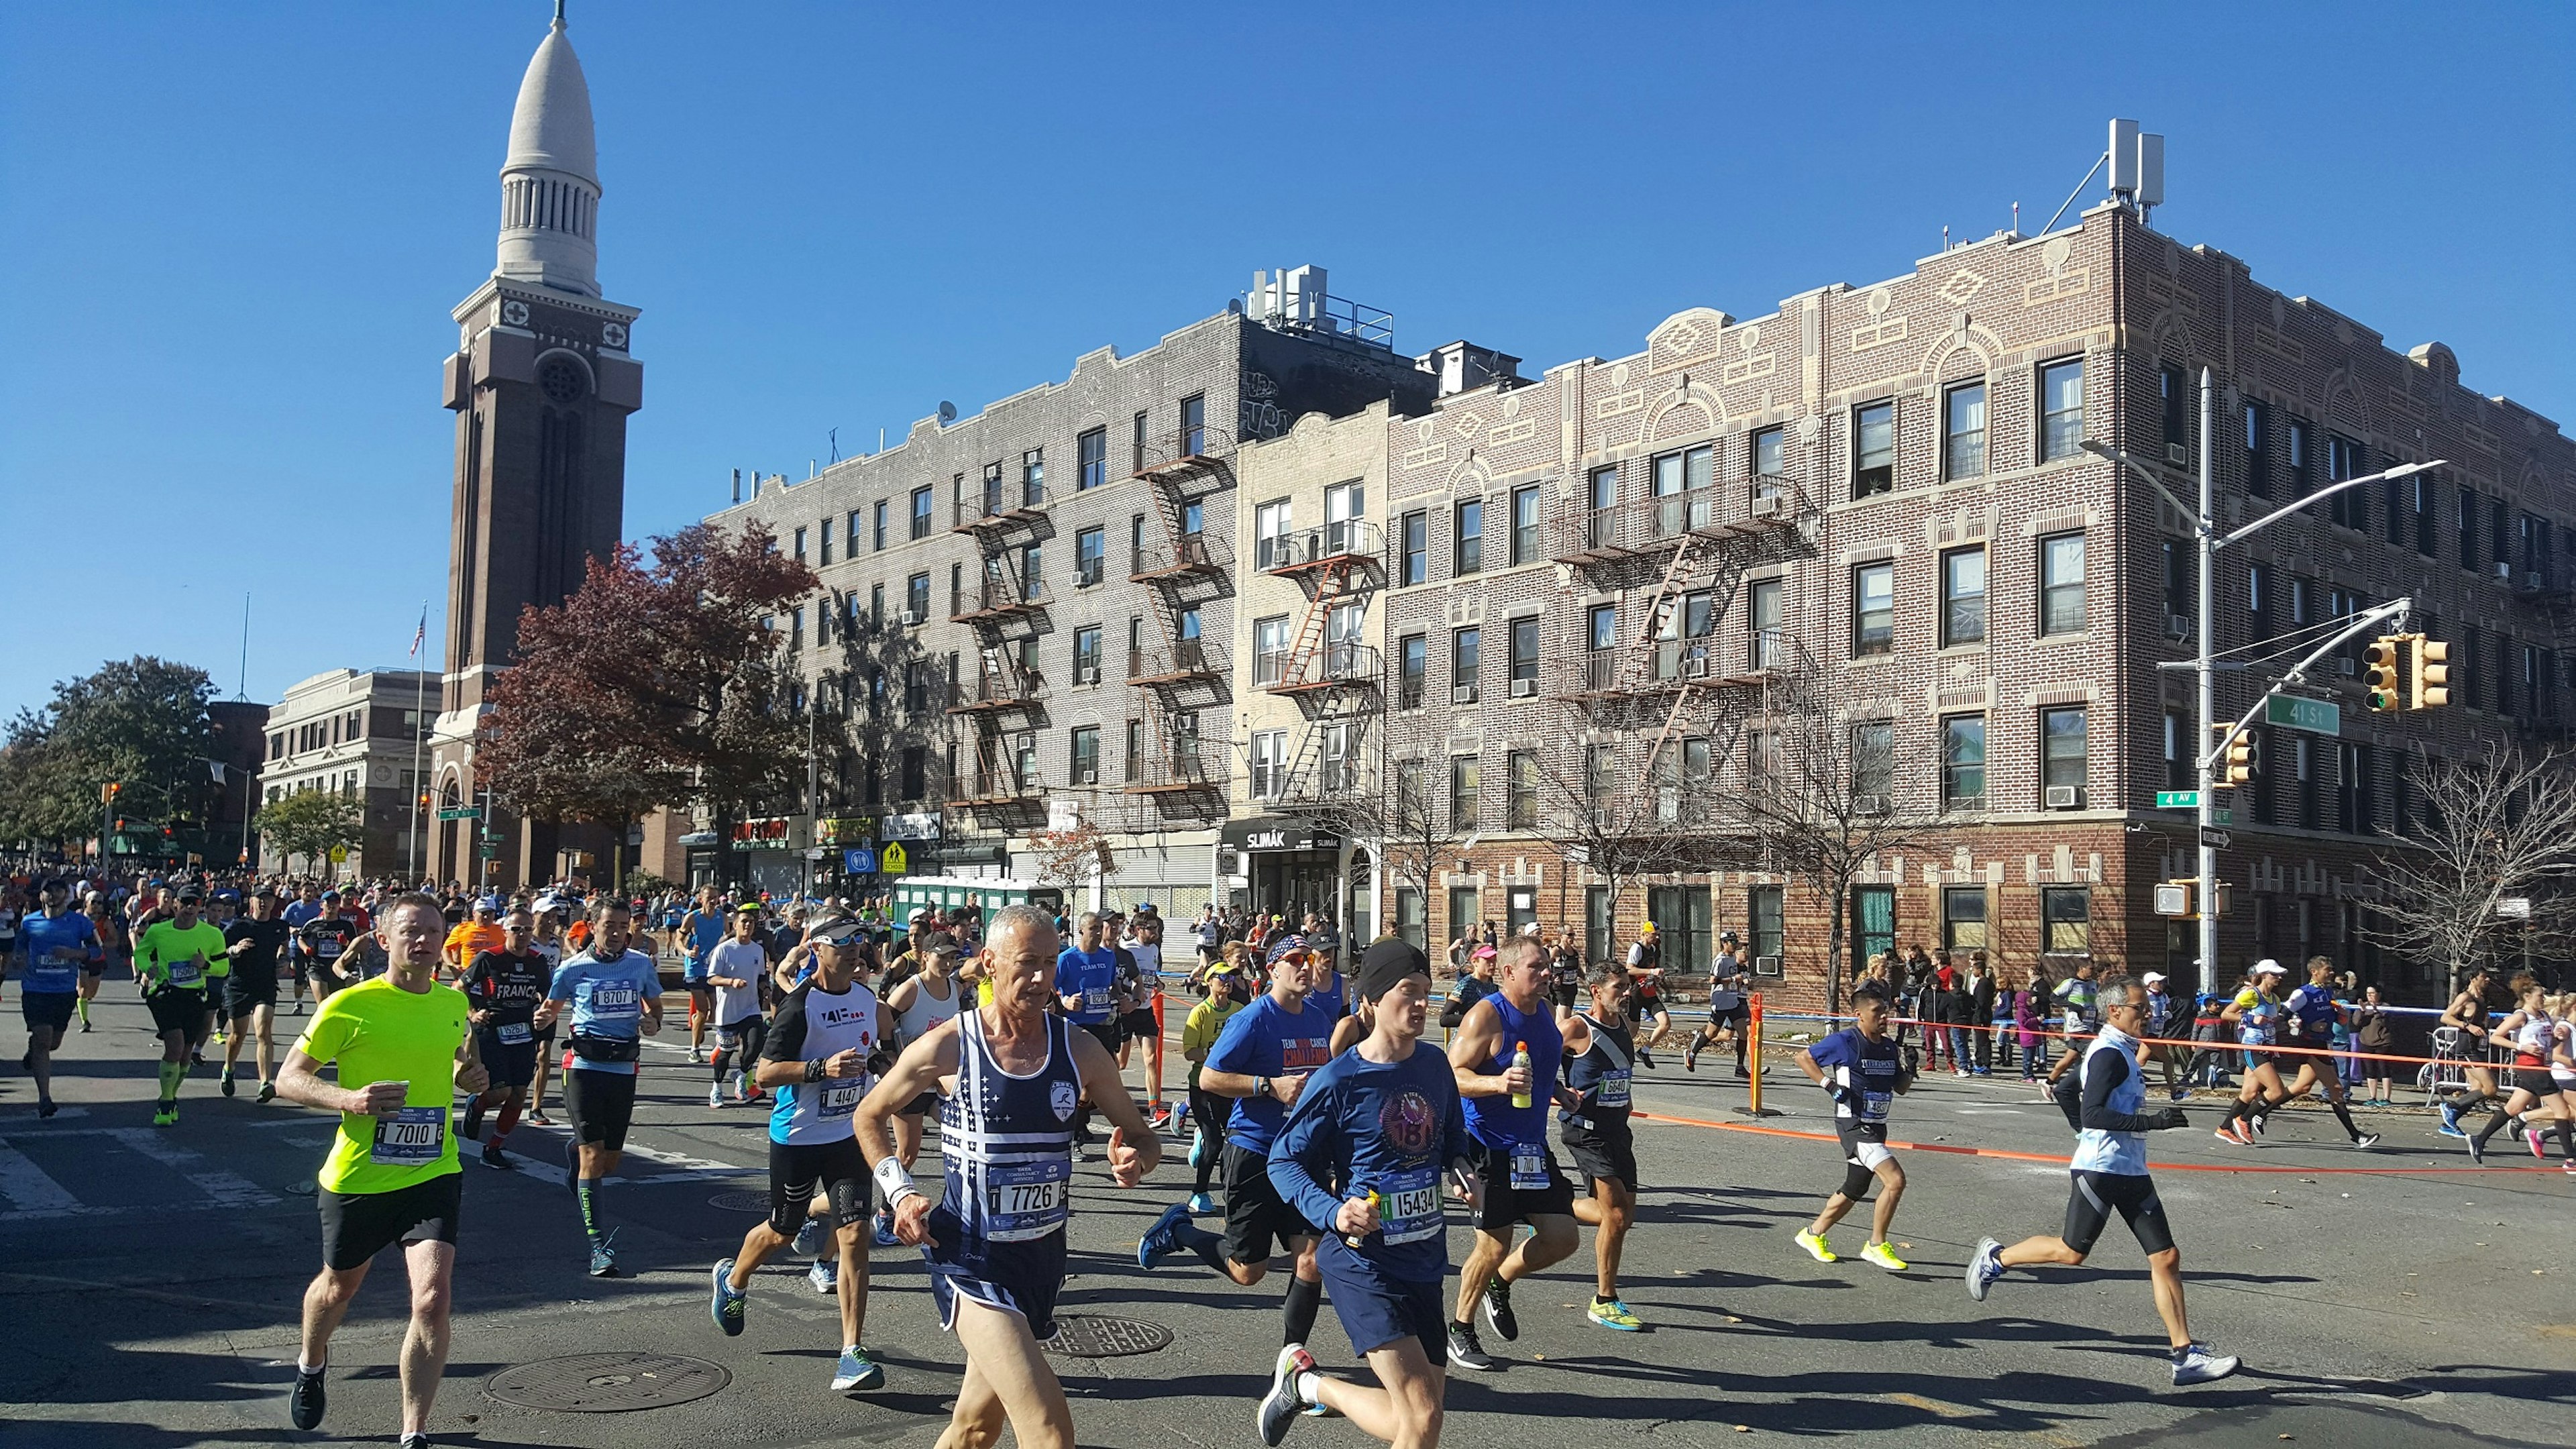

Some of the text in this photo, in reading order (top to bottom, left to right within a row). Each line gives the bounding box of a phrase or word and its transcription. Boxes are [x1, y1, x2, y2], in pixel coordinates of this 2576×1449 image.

[2290, 703, 2324, 725] 41 St
[2165, 793, 2191, 806] 4 AV
[2214, 810, 2229, 822] 41 ST
[916, 822, 934, 833] SHOP
[1247, 829, 1285, 849] SLIMÁK
[1317, 838, 1338, 847] SLIMÁK
[2205, 833, 2214, 841] ONE
[604, 991, 628, 1004] 8707
[504, 1024, 524, 1036] 15267
[1282, 1039, 1297, 1049] TEAM
[835, 1088, 857, 1106] 4147
[395, 1124, 430, 1144] 7010
[1393, 1177, 1421, 1185] CONSULTANCY
[1012, 1184, 1052, 1212] 7726
[1397, 1188, 1434, 1217] 15434
